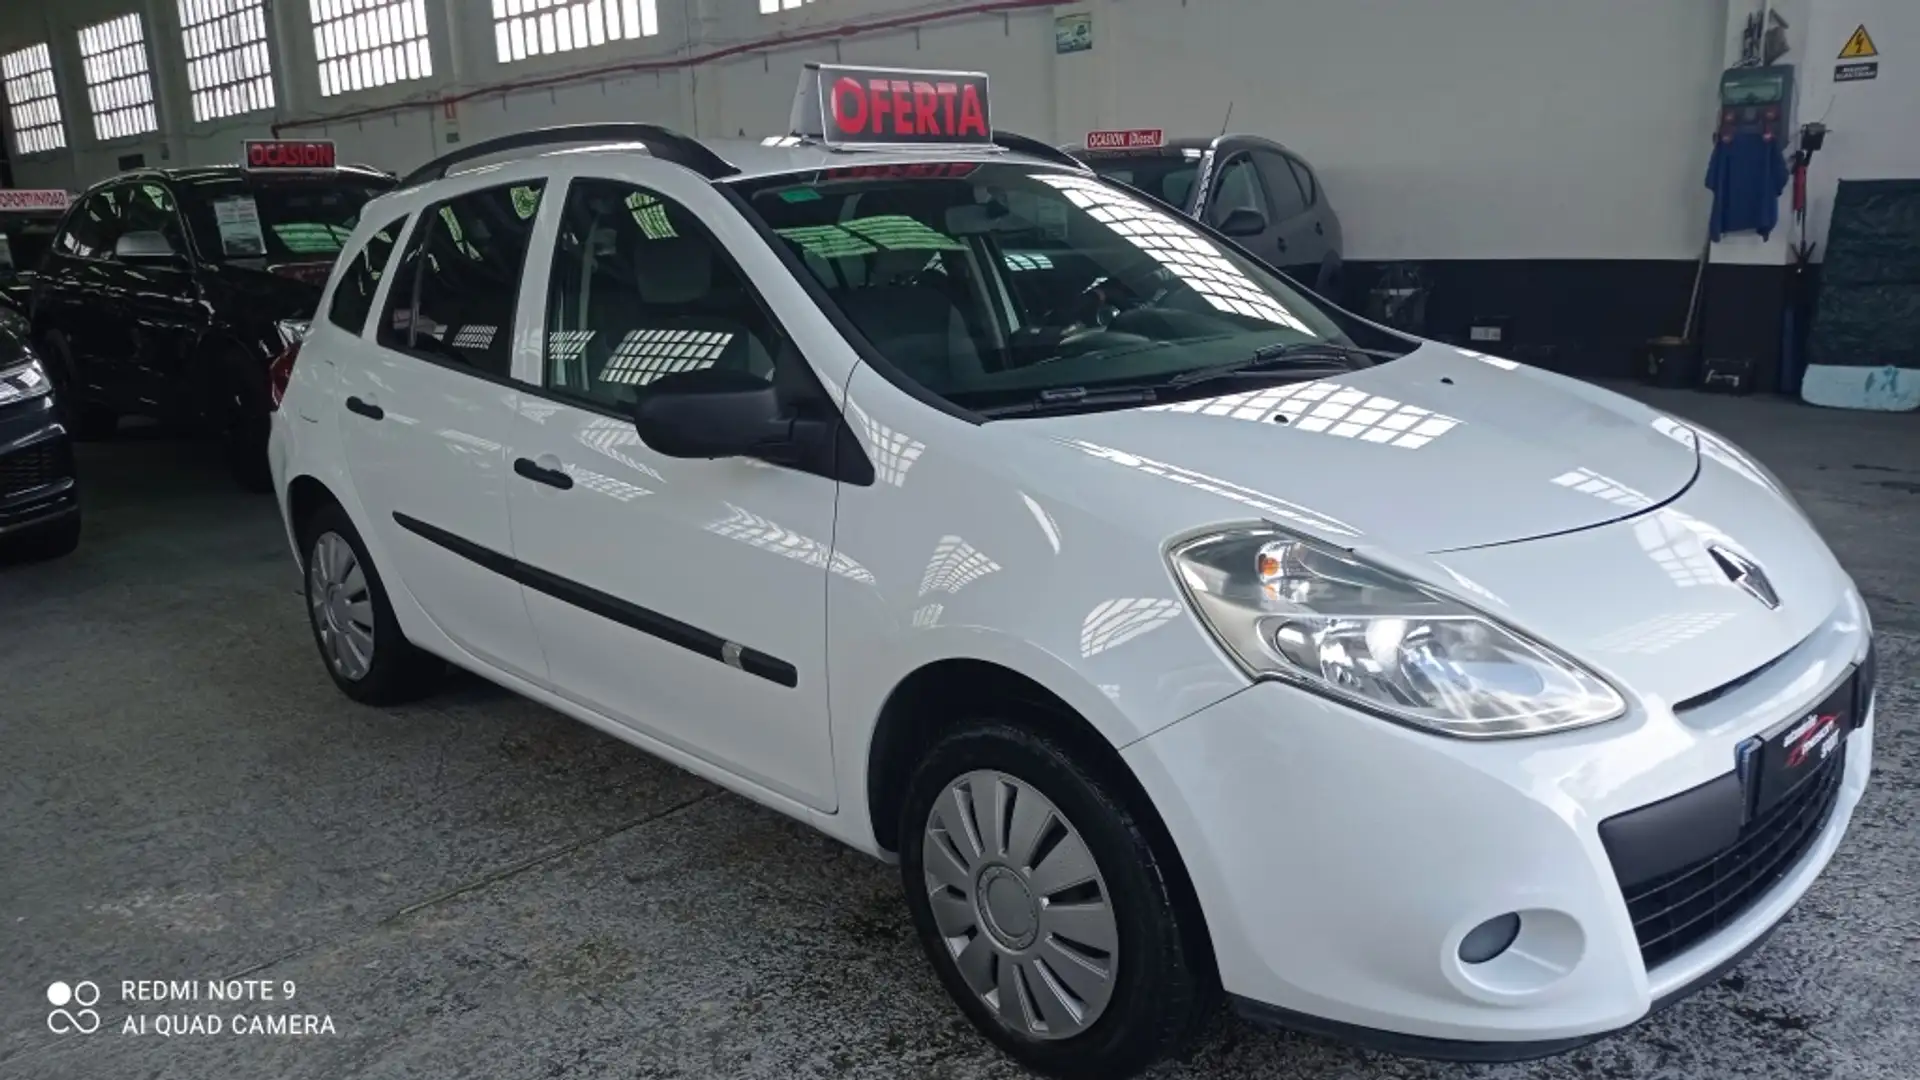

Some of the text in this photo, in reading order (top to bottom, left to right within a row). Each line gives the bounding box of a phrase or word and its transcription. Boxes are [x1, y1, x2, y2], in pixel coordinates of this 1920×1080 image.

[831, 77, 987, 136] OFERTA
[1090, 132, 1125, 146] OCASION
[250, 143, 333, 166] OCASION
